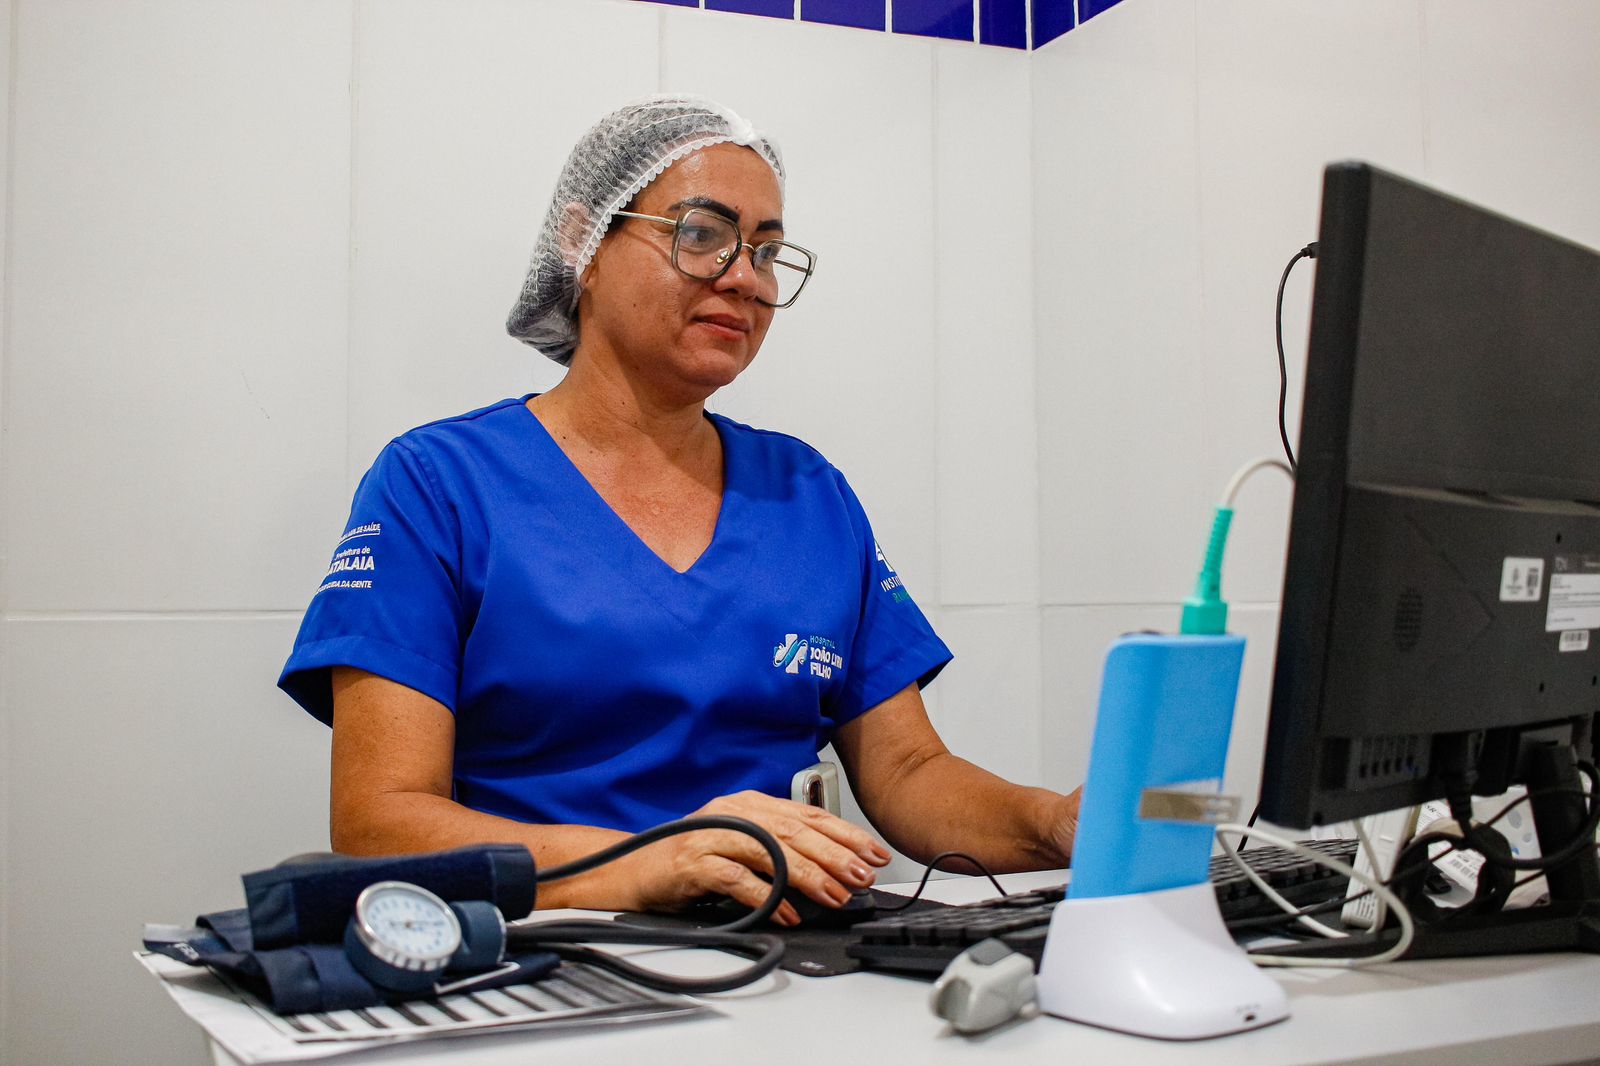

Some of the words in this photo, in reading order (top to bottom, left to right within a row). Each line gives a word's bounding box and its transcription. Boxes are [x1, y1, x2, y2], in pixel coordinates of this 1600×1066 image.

[361, 545, 371, 554] de
[350, 580, 373, 589] GENTE
[810, 646, 831, 663] JOÃO
[811, 662, 831, 679] FILHO
